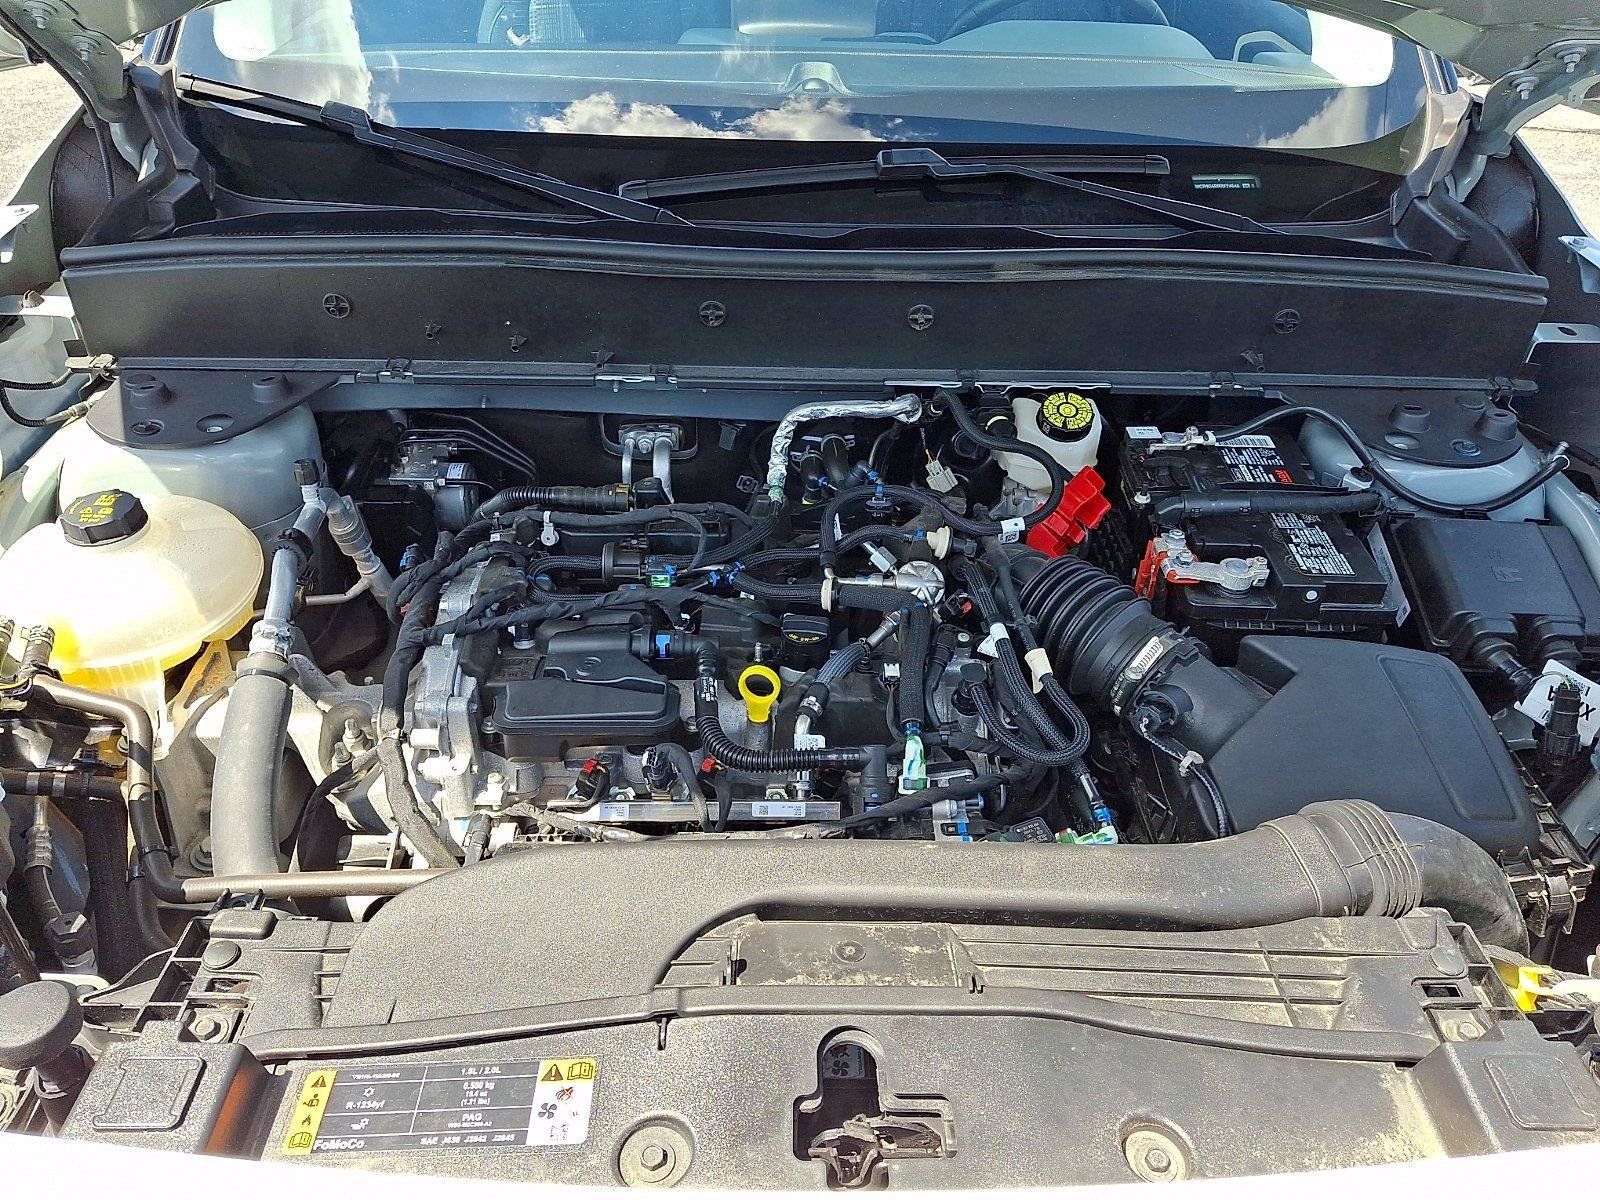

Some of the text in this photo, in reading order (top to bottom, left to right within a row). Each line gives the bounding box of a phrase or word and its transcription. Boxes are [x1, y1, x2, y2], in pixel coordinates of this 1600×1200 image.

[484, 1066, 502, 1075] 2.0L
[345, 1100, 386, 1110] R-1234yf
[462, 1112, 483, 1122] PAG
[313, 1138, 366, 1151] FoMoCo
